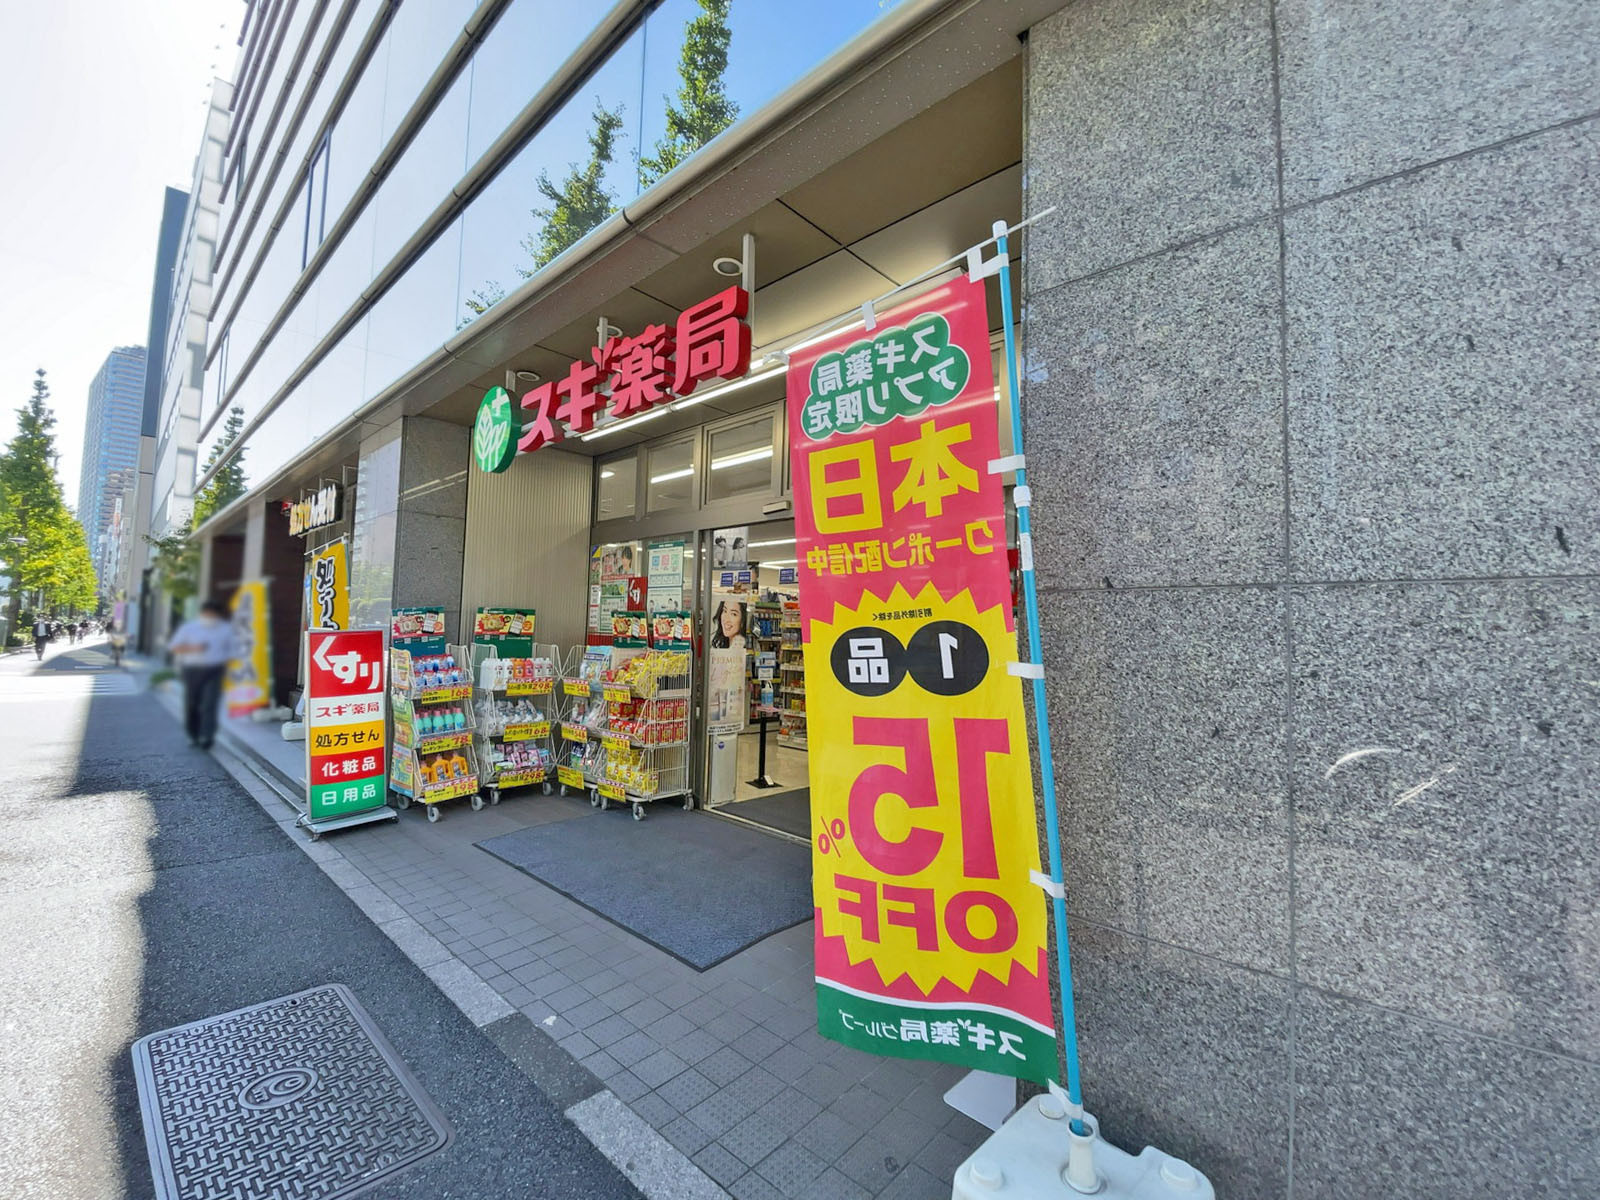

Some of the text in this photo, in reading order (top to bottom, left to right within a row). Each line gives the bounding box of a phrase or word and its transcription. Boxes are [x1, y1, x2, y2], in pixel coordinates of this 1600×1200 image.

[517, 285, 751, 451] スギ薬局
[312, 635, 381, 690] くすり
[316, 702, 380, 718] スギ薬局
[315, 729, 380, 748] 処方せん
[321, 756, 377, 777] 化粧品
[321, 784, 376, 806] 日用品
